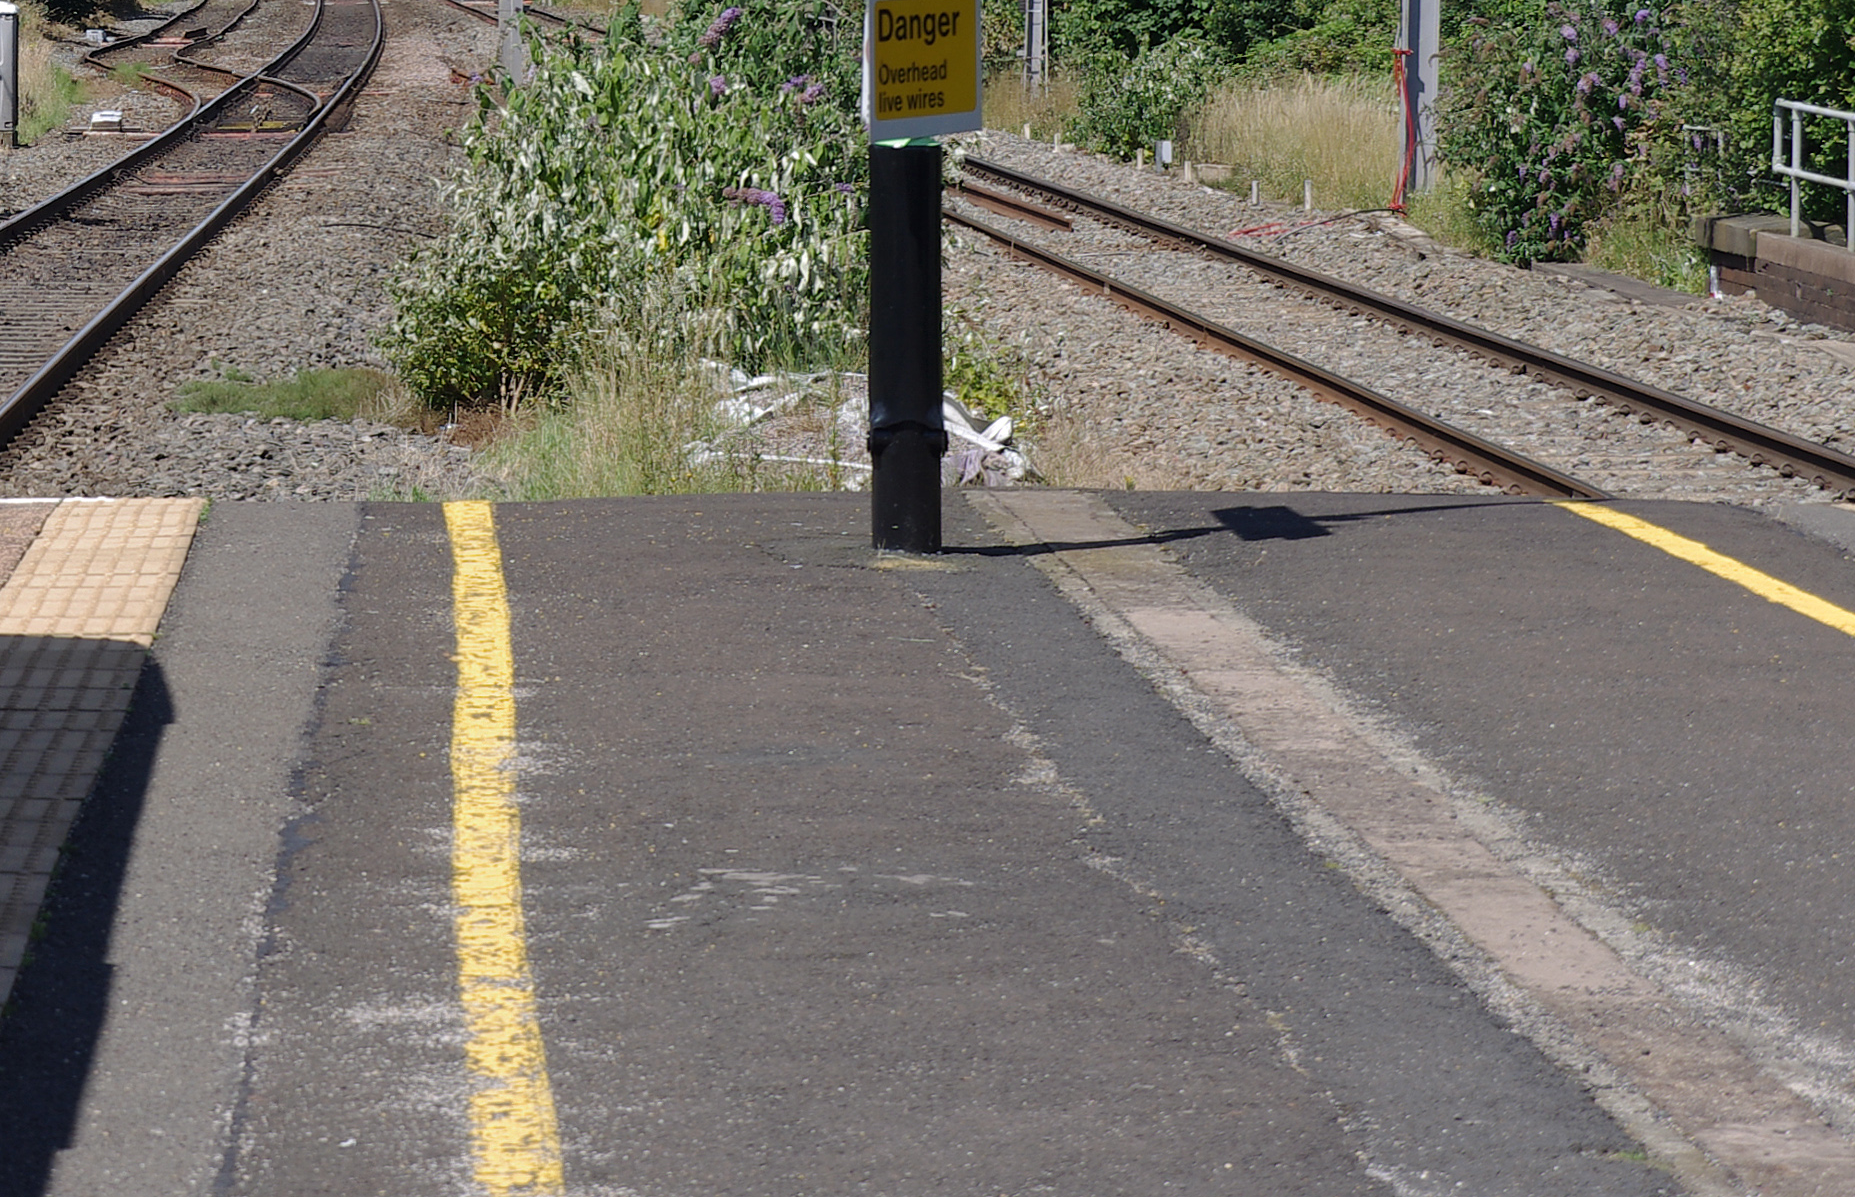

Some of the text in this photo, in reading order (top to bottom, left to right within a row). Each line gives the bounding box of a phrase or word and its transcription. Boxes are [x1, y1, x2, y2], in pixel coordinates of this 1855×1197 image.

[878, 9, 960, 46] Danger
[879, 59, 947, 85] Overhead
[879, 88, 945, 113] live wires
